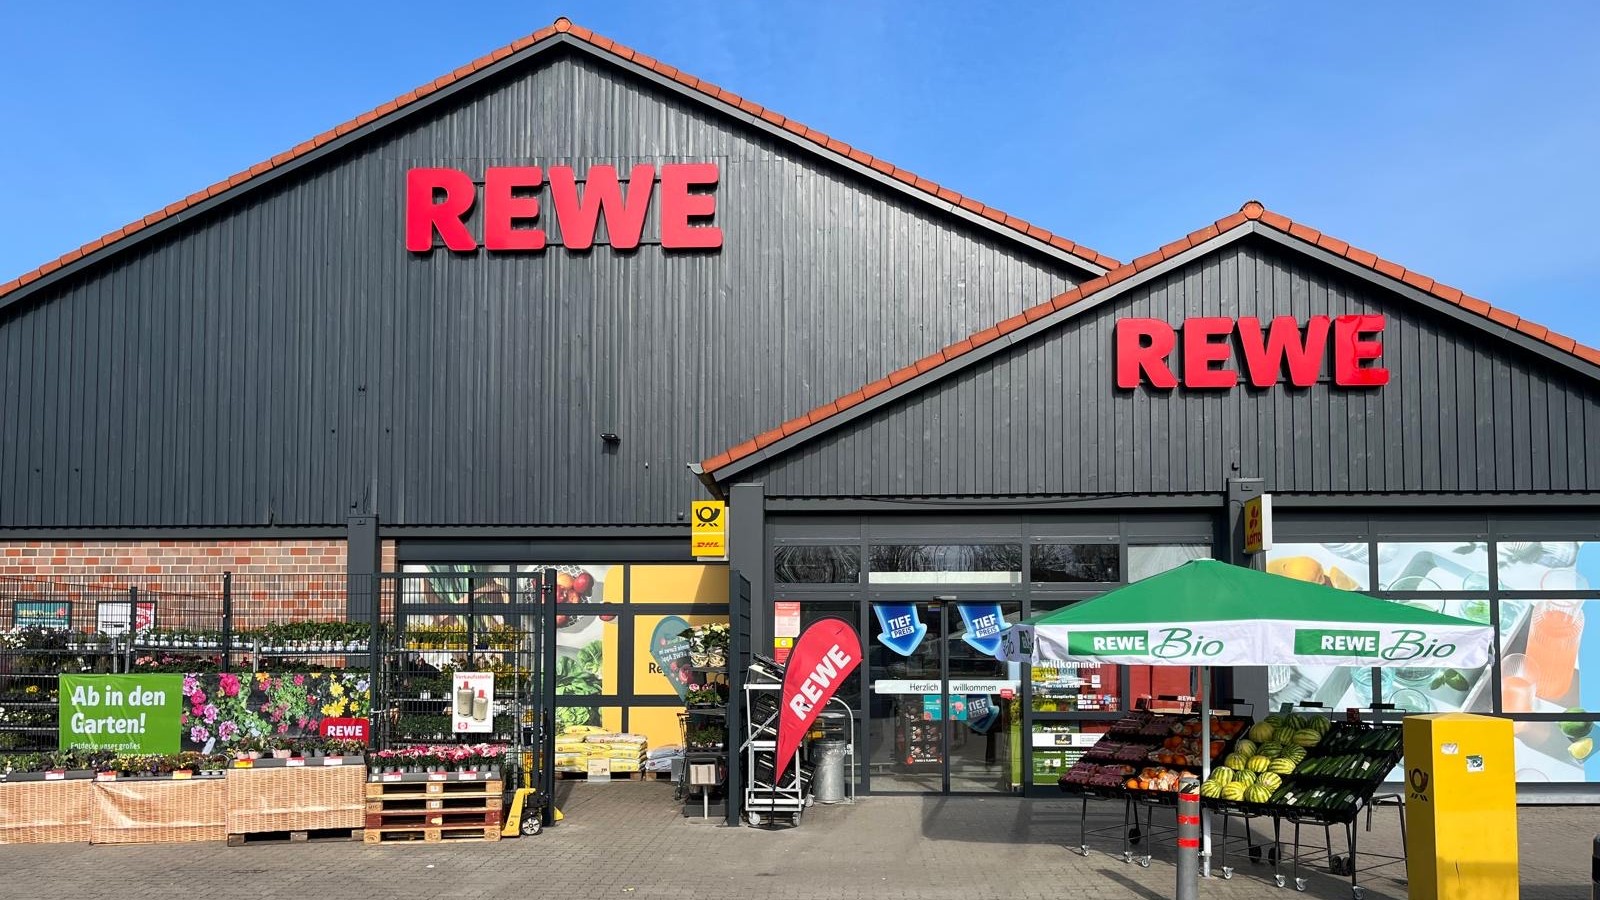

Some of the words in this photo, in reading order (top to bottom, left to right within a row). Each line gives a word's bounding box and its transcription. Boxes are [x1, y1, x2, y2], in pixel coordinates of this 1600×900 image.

[406, 164, 723, 252] REWE
[1116, 315, 1389, 388] REWE
[1247, 532, 1262, 546] LOTTO
[888, 614, 911, 630] TIEF
[972, 614, 996, 630] TIEF
[894, 626, 913, 637] PREIS
[979, 625, 999, 637] PREIS
[1093, 636, 1146, 651] REWE
[1151, 627, 1224, 659] Bio
[1321, 635, 1376, 652] REWE
[1381, 629, 1456, 661] Bio
[790, 644, 851, 720] REWE
[909, 683, 939, 691] Herzlich
[952, 683, 997, 691] willkommen
[71, 685, 100, 706] Ab
[105, 685, 123, 706] in
[128, 685, 166, 706] den
[968, 698, 987, 711] TIEF
[71, 712, 146, 734] Garten!
[327, 725, 363, 736] REWE
[119, 741, 141, 751] großes
